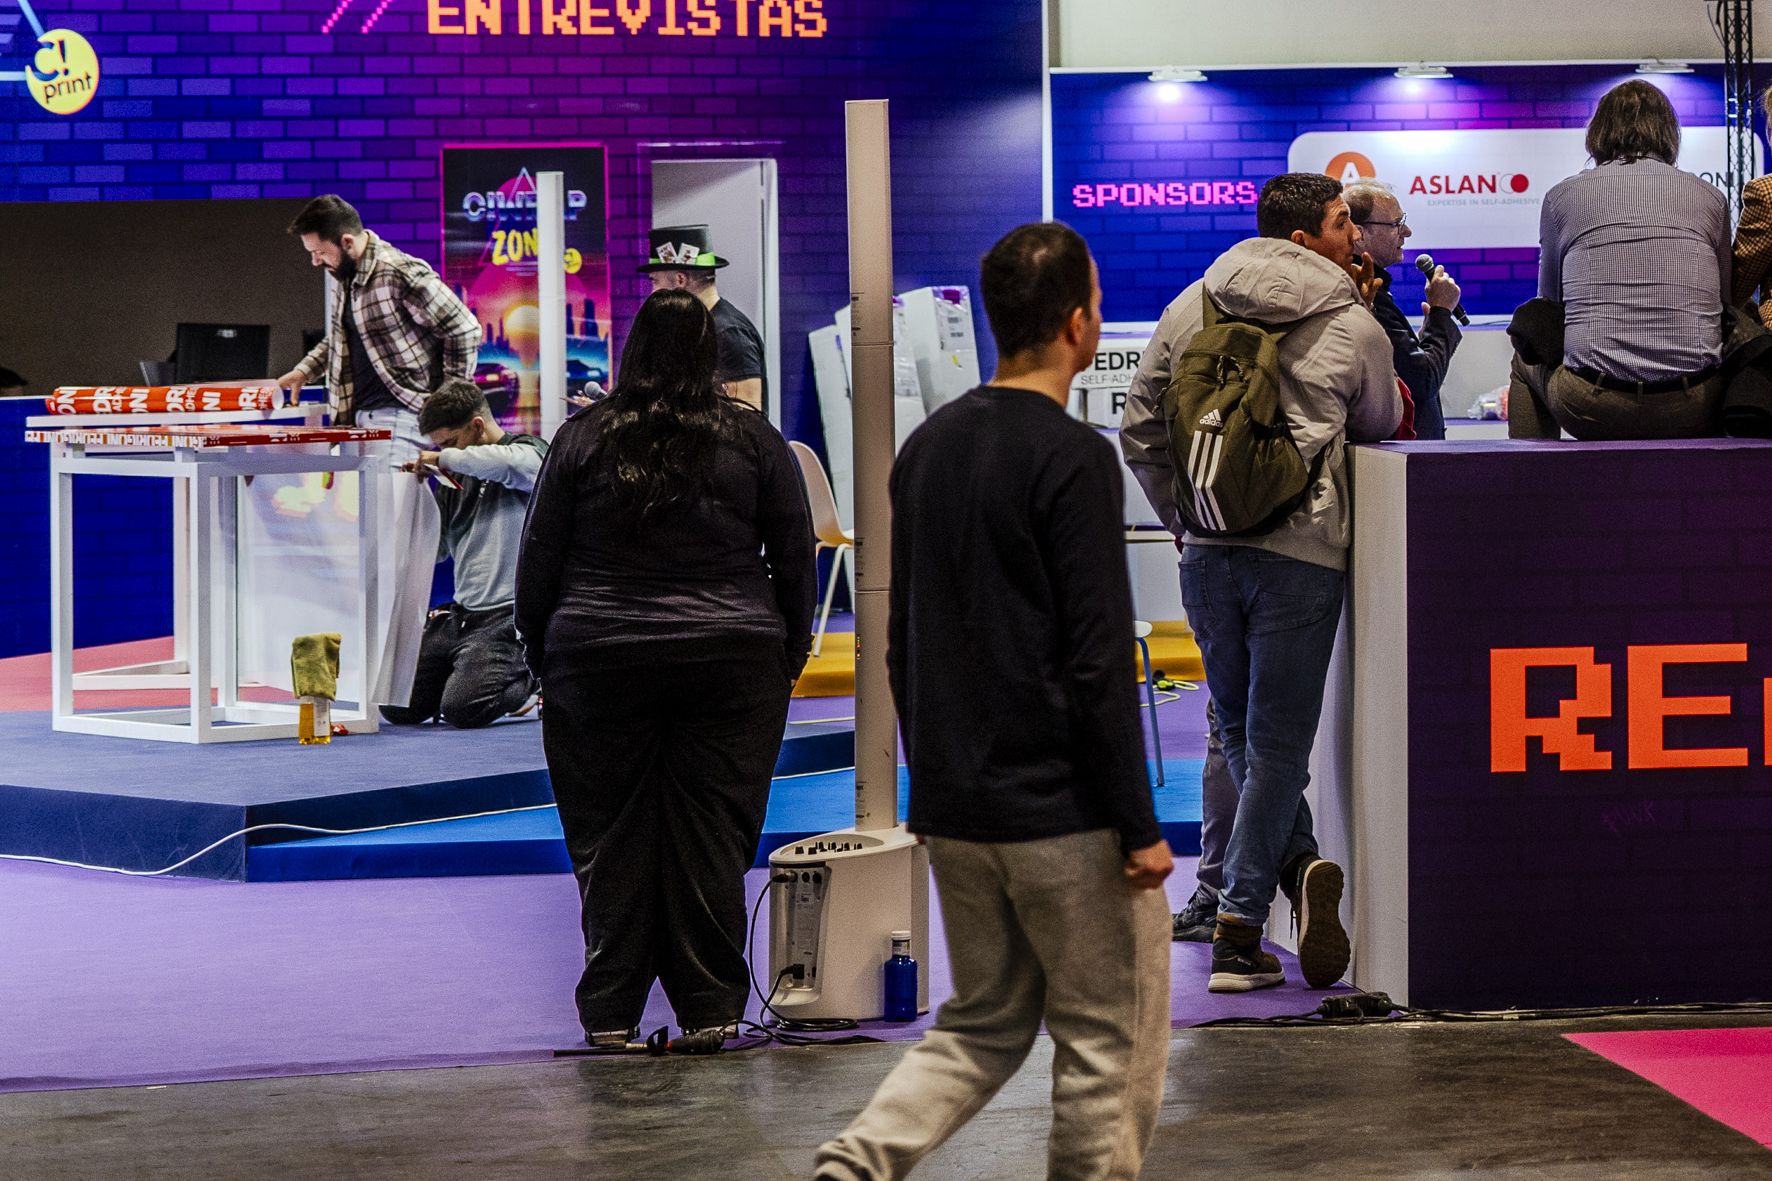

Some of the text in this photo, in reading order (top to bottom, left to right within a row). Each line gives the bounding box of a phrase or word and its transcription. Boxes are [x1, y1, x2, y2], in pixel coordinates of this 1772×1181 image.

[44, 73, 92, 104] print
[1073, 181, 1258, 208] SPONSORS
[1409, 174, 1497, 195] ASLAN
[1427, 198, 1467, 207] EXPERTISE
[491, 227, 539, 266] ZON
[1199, 418, 1223, 428] adidas
